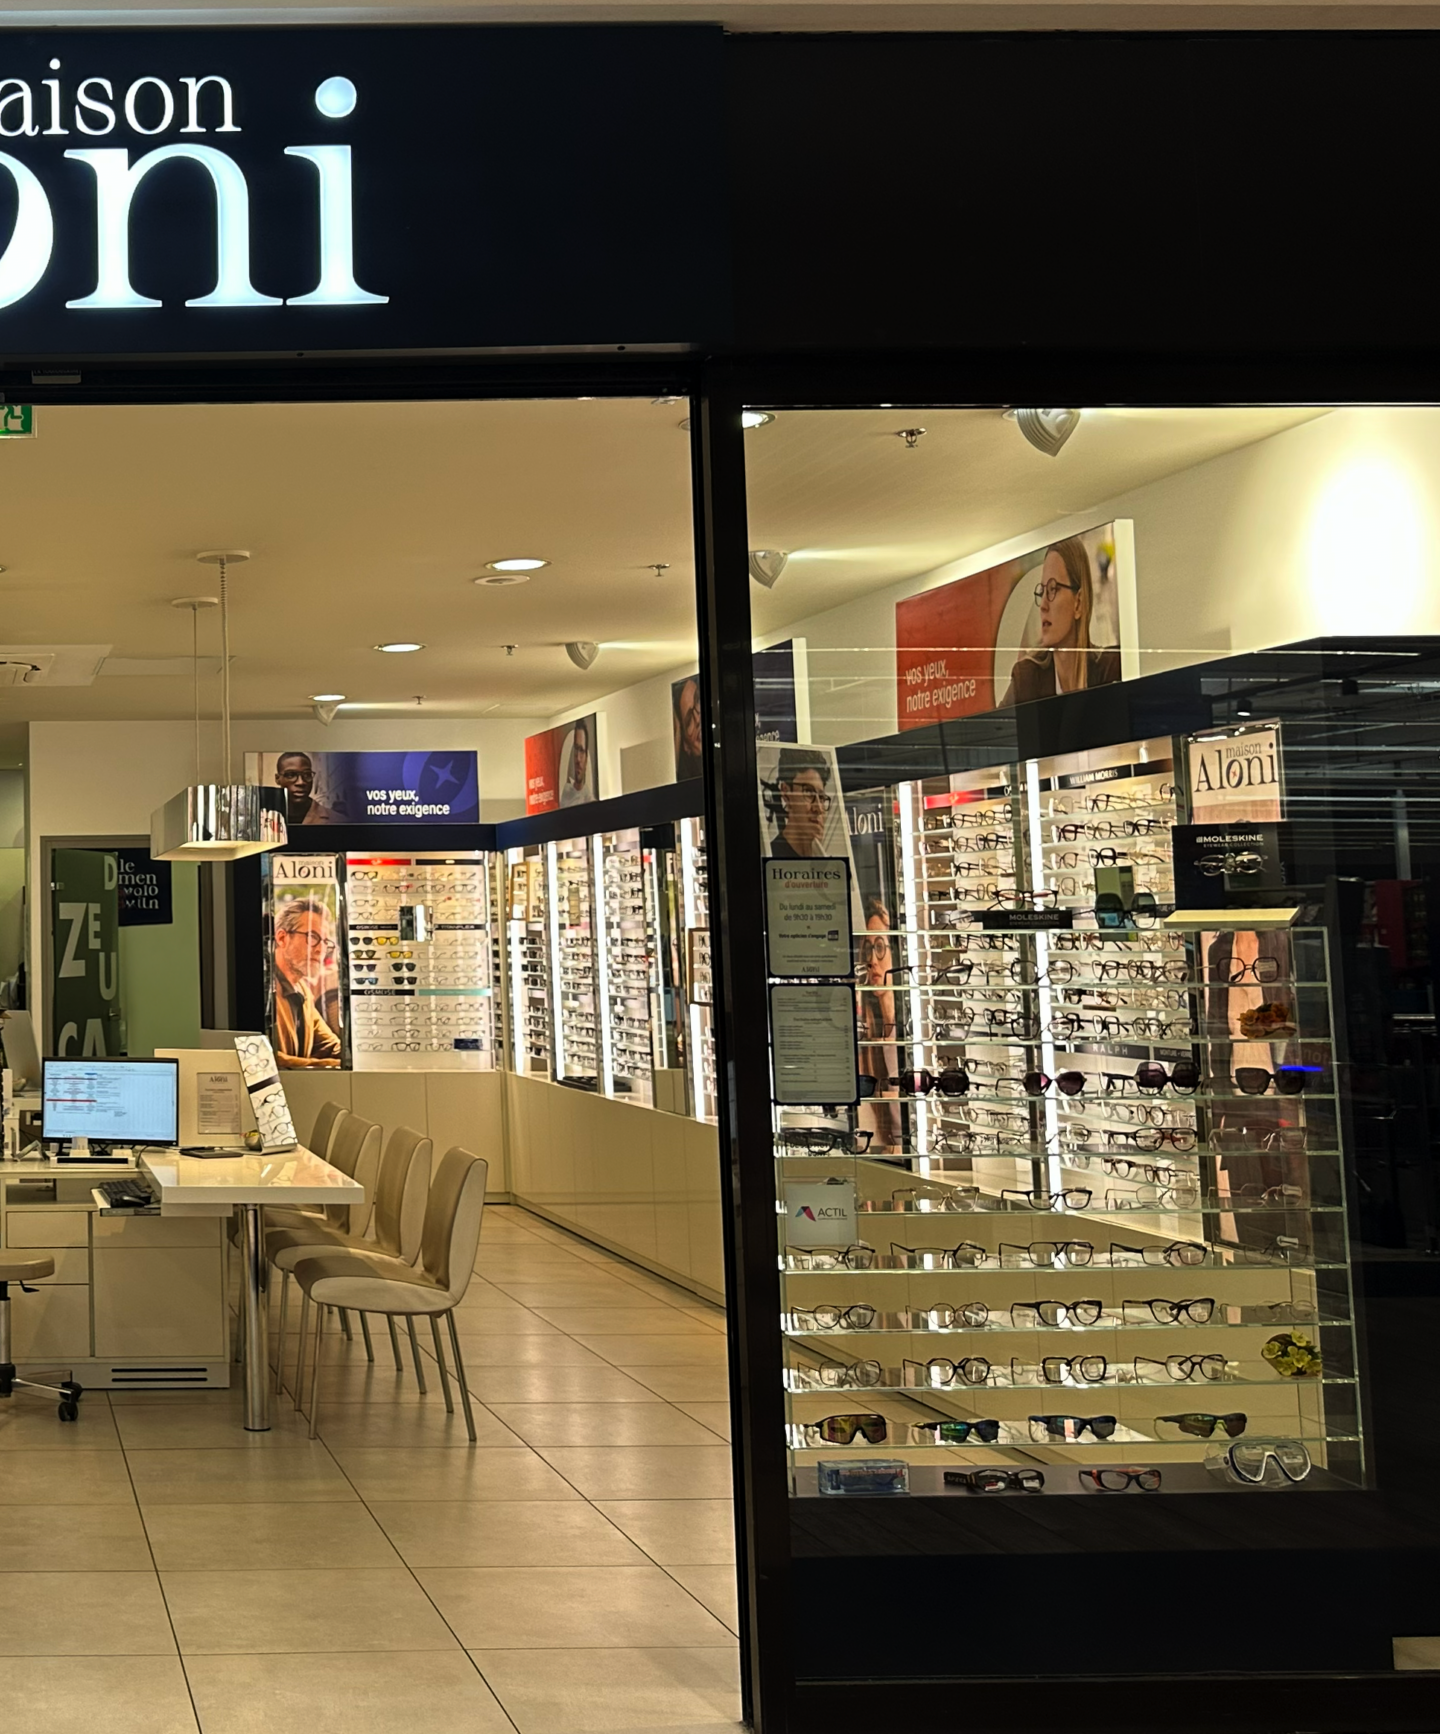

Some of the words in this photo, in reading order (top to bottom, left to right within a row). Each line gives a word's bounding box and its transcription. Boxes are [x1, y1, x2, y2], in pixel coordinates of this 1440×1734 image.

[905, 666, 922, 686] vos
[923, 659, 949, 687] yeux,
[906, 689, 931, 713] notre
[932, 679, 976, 708] exigence
[1225, 741, 1262, 758] maison
[1193, 741, 1279, 793] Aloni
[366, 791, 388, 801] vos
[389, 789, 419, 804] yeux,
[367, 803, 397, 816] notre
[398, 802, 450, 818] exigence
[1203, 833, 1264, 843] MOLESKINE
[274, 862, 334, 879] Aloni
[772, 868, 842, 880] Horaires
[784, 880, 829, 889] d'ouverture
[779, 903, 789, 911] Du
[789, 903, 805, 911] lundi
[814, 903, 837, 911] samedi
[1009, 913, 1059, 921] MOLESKINE
[1092, 1044, 1129, 1055] RALPH
[817, 1207, 848, 1218] ACTIL
